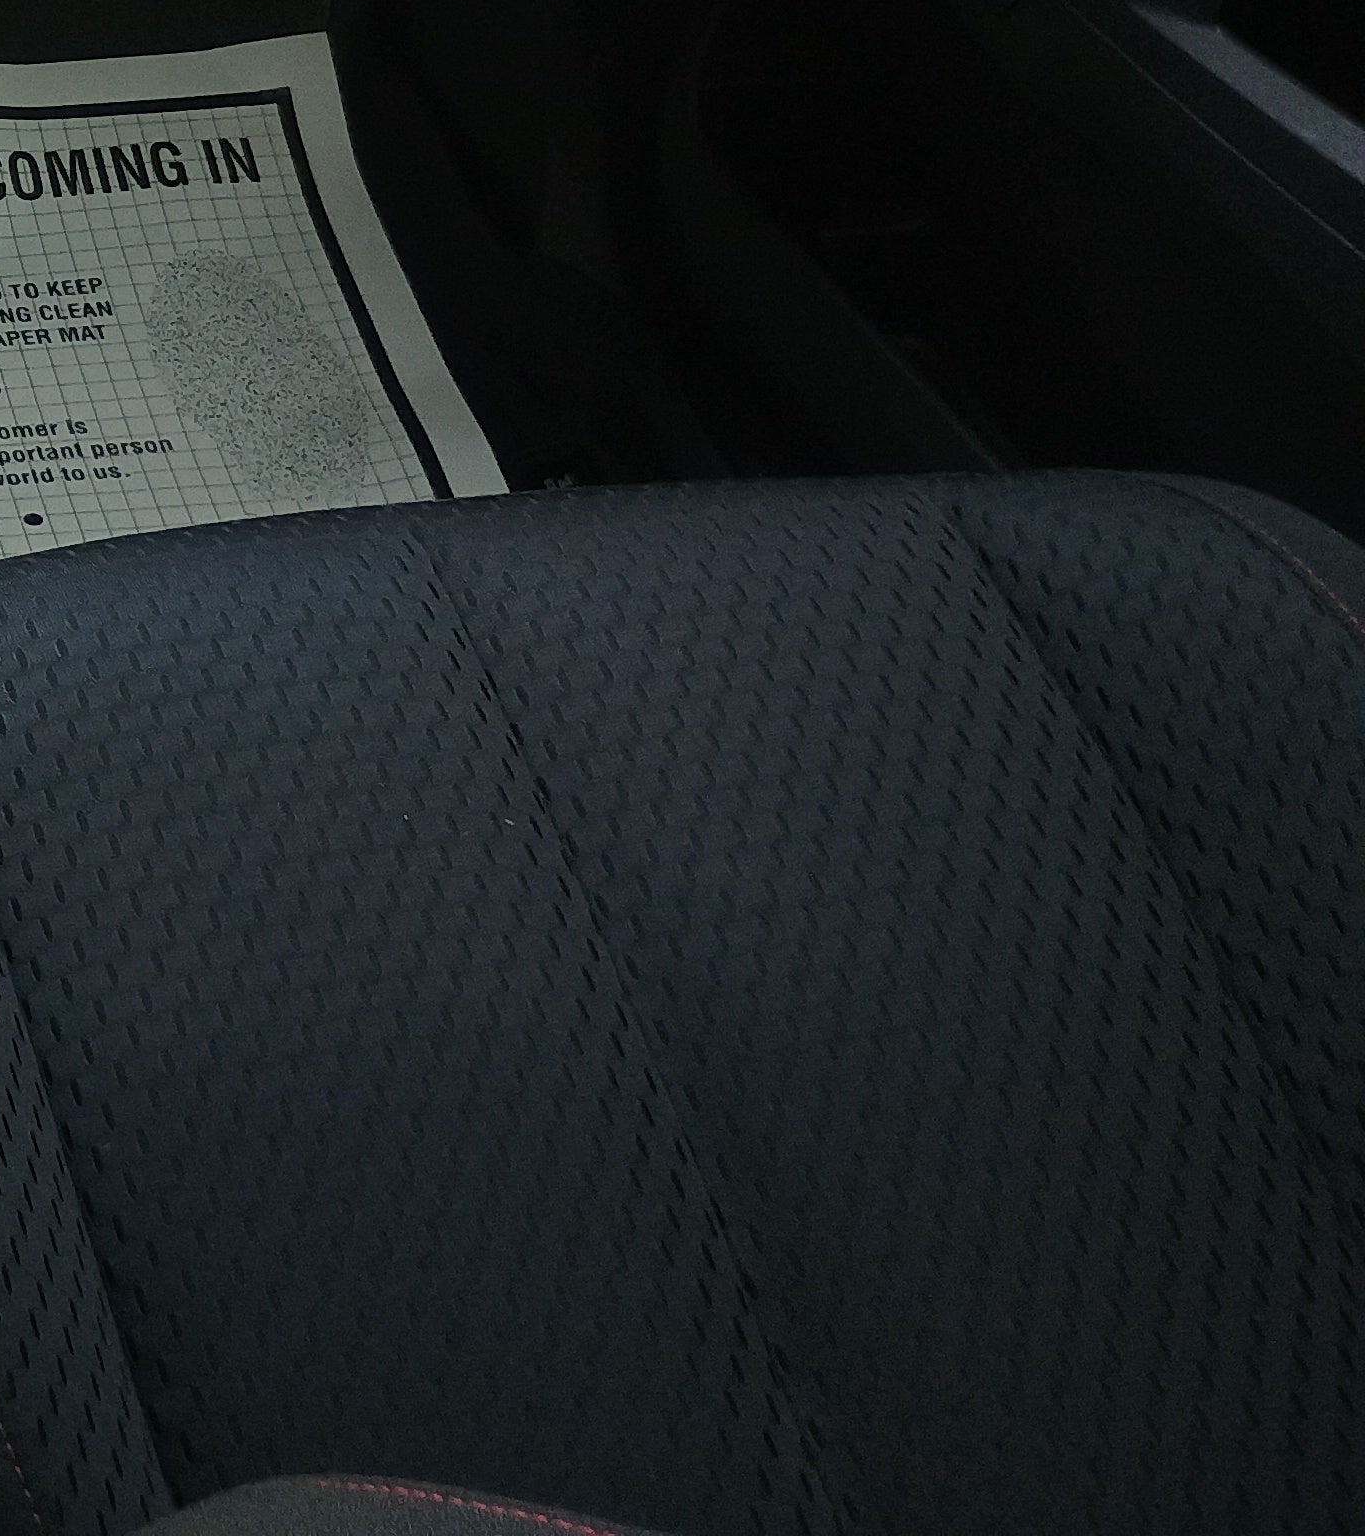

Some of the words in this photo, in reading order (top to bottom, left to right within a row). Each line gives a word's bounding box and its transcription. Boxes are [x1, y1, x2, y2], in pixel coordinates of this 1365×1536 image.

[201, 136, 261, 184] IN
[8, 282, 39, 300] TO
[45, 277, 103, 297] KEEP
[38, 301, 114, 321] CLEAN
[59, 324, 106, 343] MAT
[66, 418, 88, 435] is
[90, 437, 174, 460] person
[59, 465, 86, 482] to
[94, 464, 132, 480] us.
